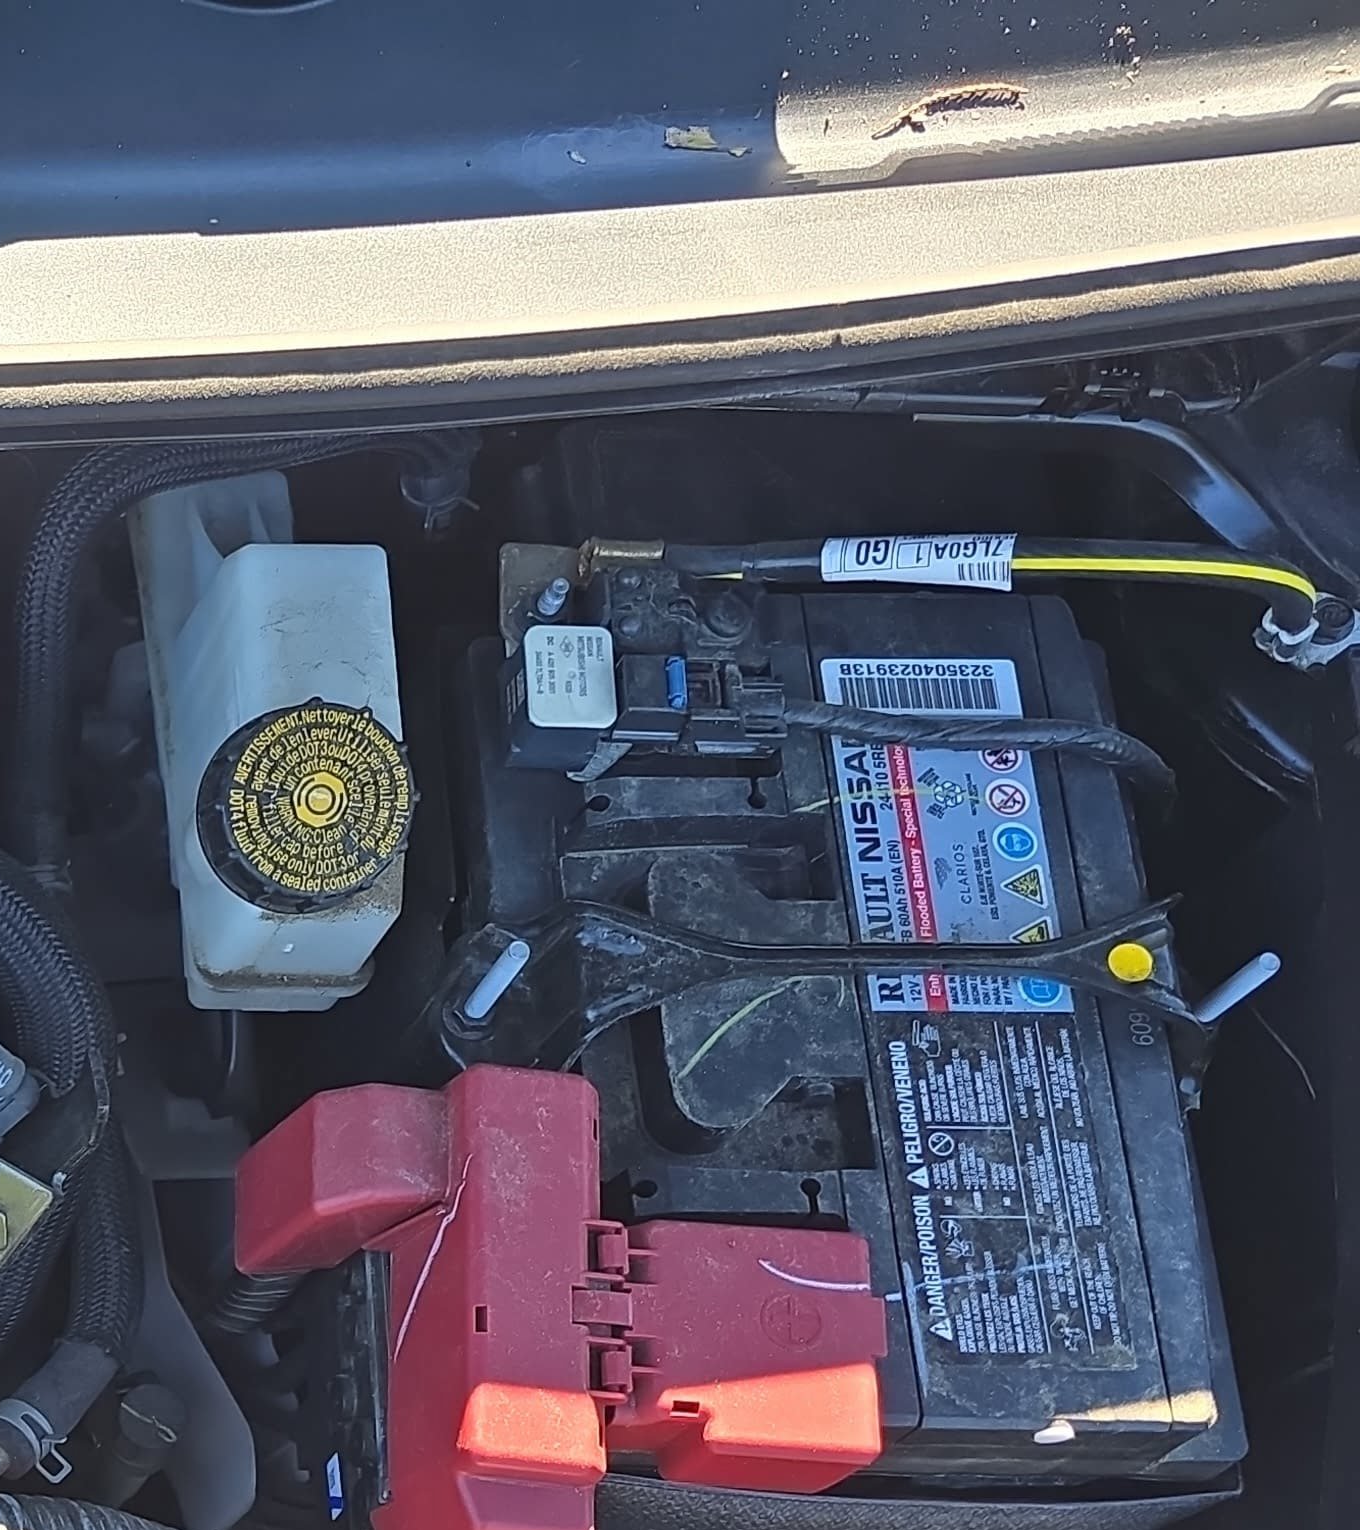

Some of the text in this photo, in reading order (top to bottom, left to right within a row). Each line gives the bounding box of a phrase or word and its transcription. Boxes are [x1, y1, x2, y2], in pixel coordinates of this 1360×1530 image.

[251, 757, 273, 791] avant
[270, 745, 284, 761] de
[284, 778, 296, 791] un
[295, 758, 354, 782] contenant
[899, 796, 919, 839] Special
[234, 821, 255, 854] fluid
[250, 851, 275, 875] from
[272, 869, 282, 881] a
[281, 872, 321, 891] sealed
[323, 857, 378, 891] container
[281, 834, 301, 854] cap
[303, 843, 344, 859] before
[287, 856, 316, 878] only
[885, 838, 904, 865] (EN)
[907, 844, 928, 890] Battery
[890, 864, 907, 896] 510A
[951, 841, 973, 906] CLARIOS
[894, 896, 911, 928] 60Ah
[913, 889, 933, 938] Flooded
[887, 1038, 948, 1318] DANGER/POISON PELIGRO/VENENO
